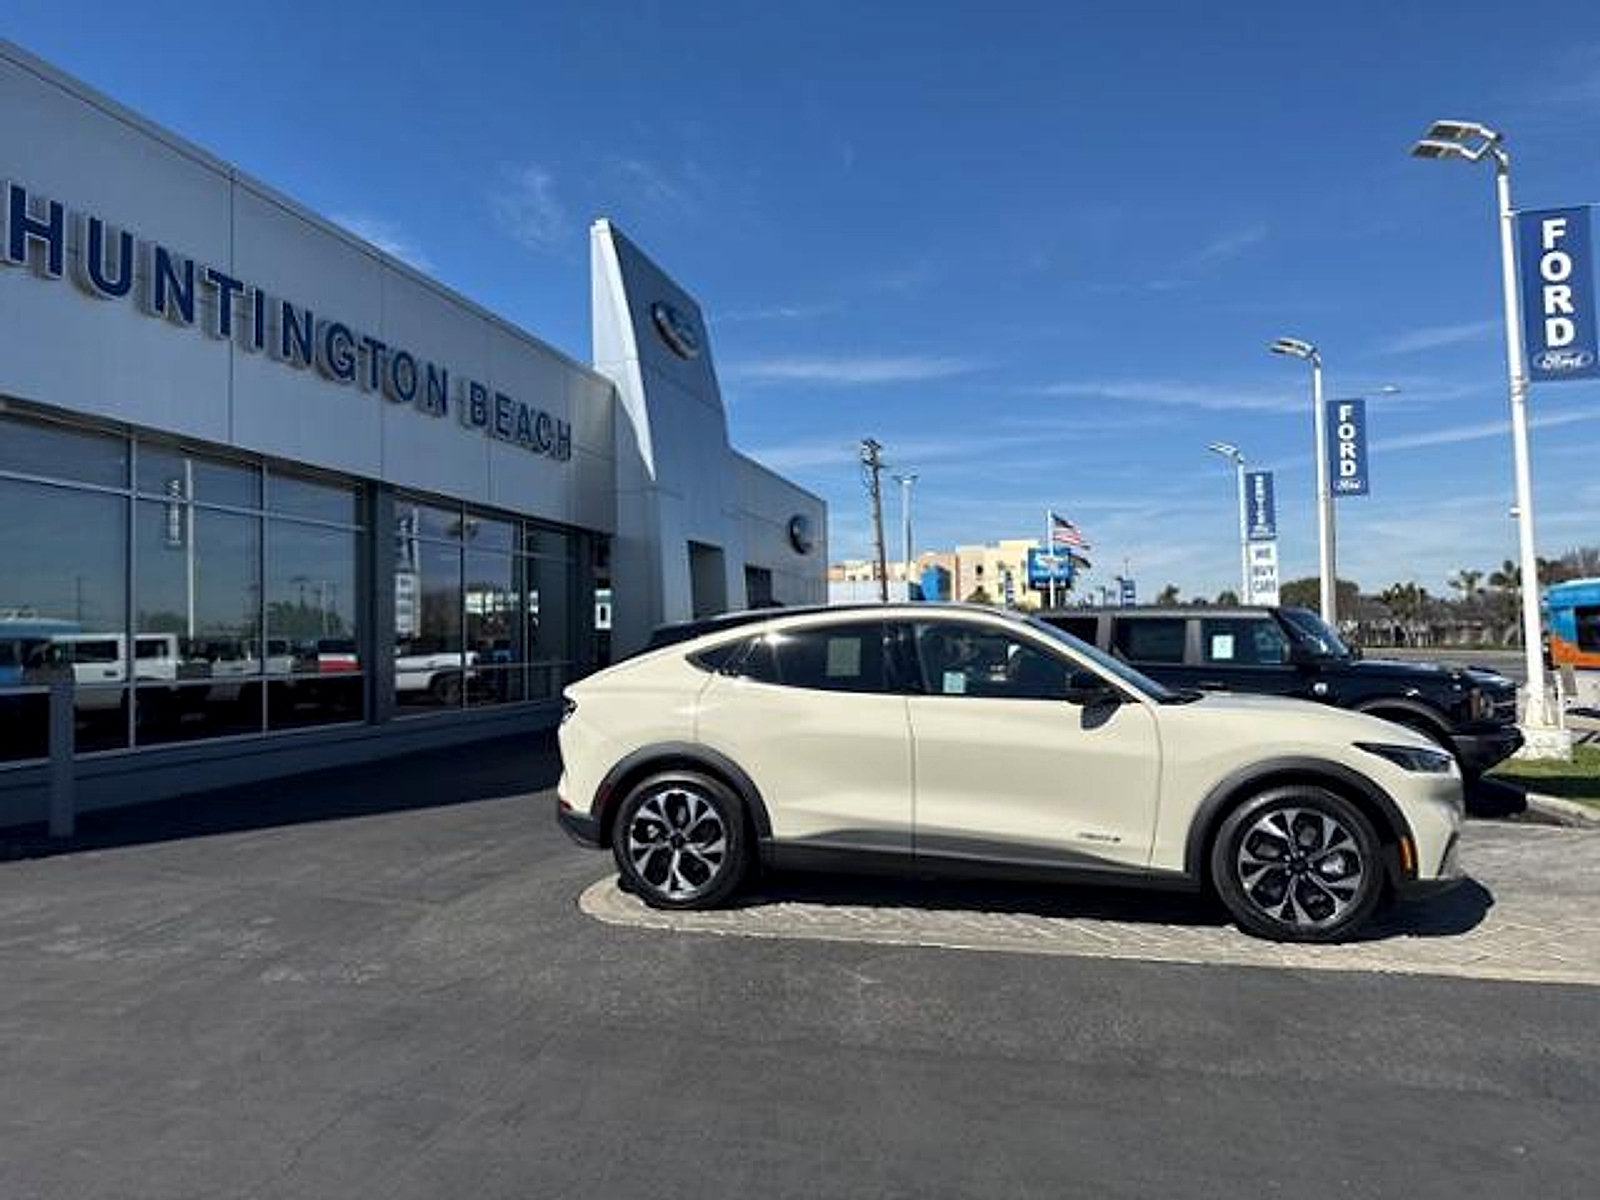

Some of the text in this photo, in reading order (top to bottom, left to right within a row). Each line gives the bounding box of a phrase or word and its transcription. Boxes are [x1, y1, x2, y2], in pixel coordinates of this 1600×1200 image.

[7, 180, 572, 461] HUNTINGTON BEACH
[1540, 218, 1574, 347] FORD
[1338, 405, 1356, 476] FORD
